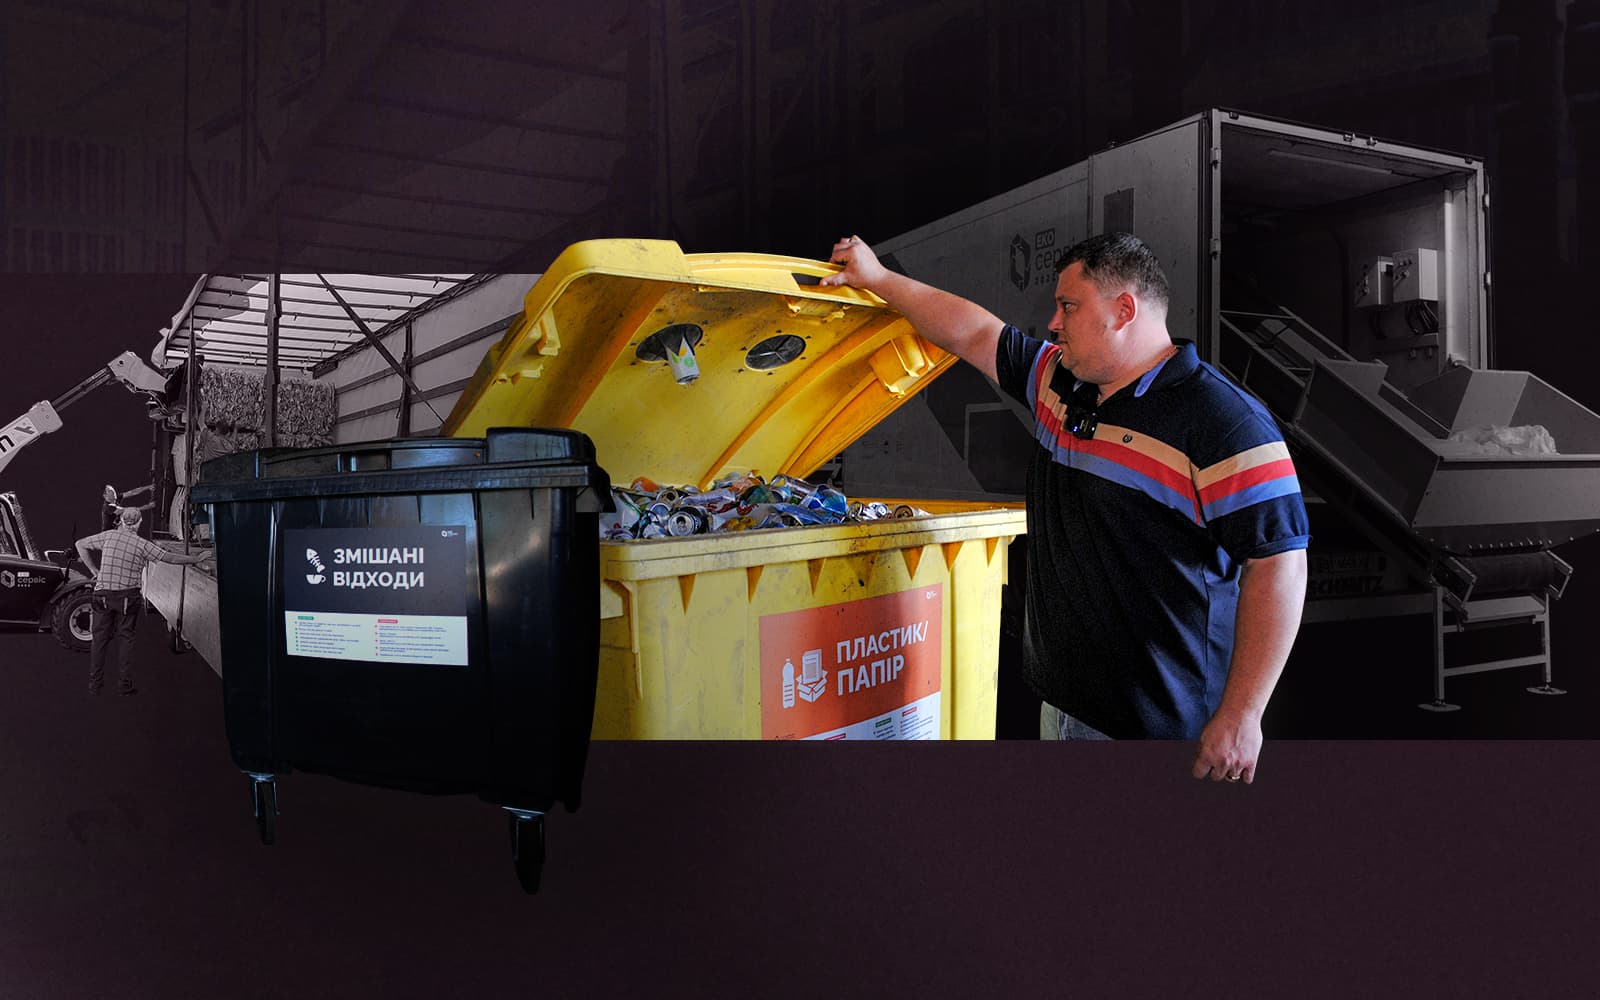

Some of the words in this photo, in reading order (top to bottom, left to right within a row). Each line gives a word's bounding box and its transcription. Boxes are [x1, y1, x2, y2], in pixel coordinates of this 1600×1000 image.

[333, 547, 424, 565] ЗМІШАНІ
[333, 571, 425, 590] ВІДХОДИ
[836, 620, 929, 664] ПЛАСТИК/
[837, 654, 905, 697] ПАПІР
